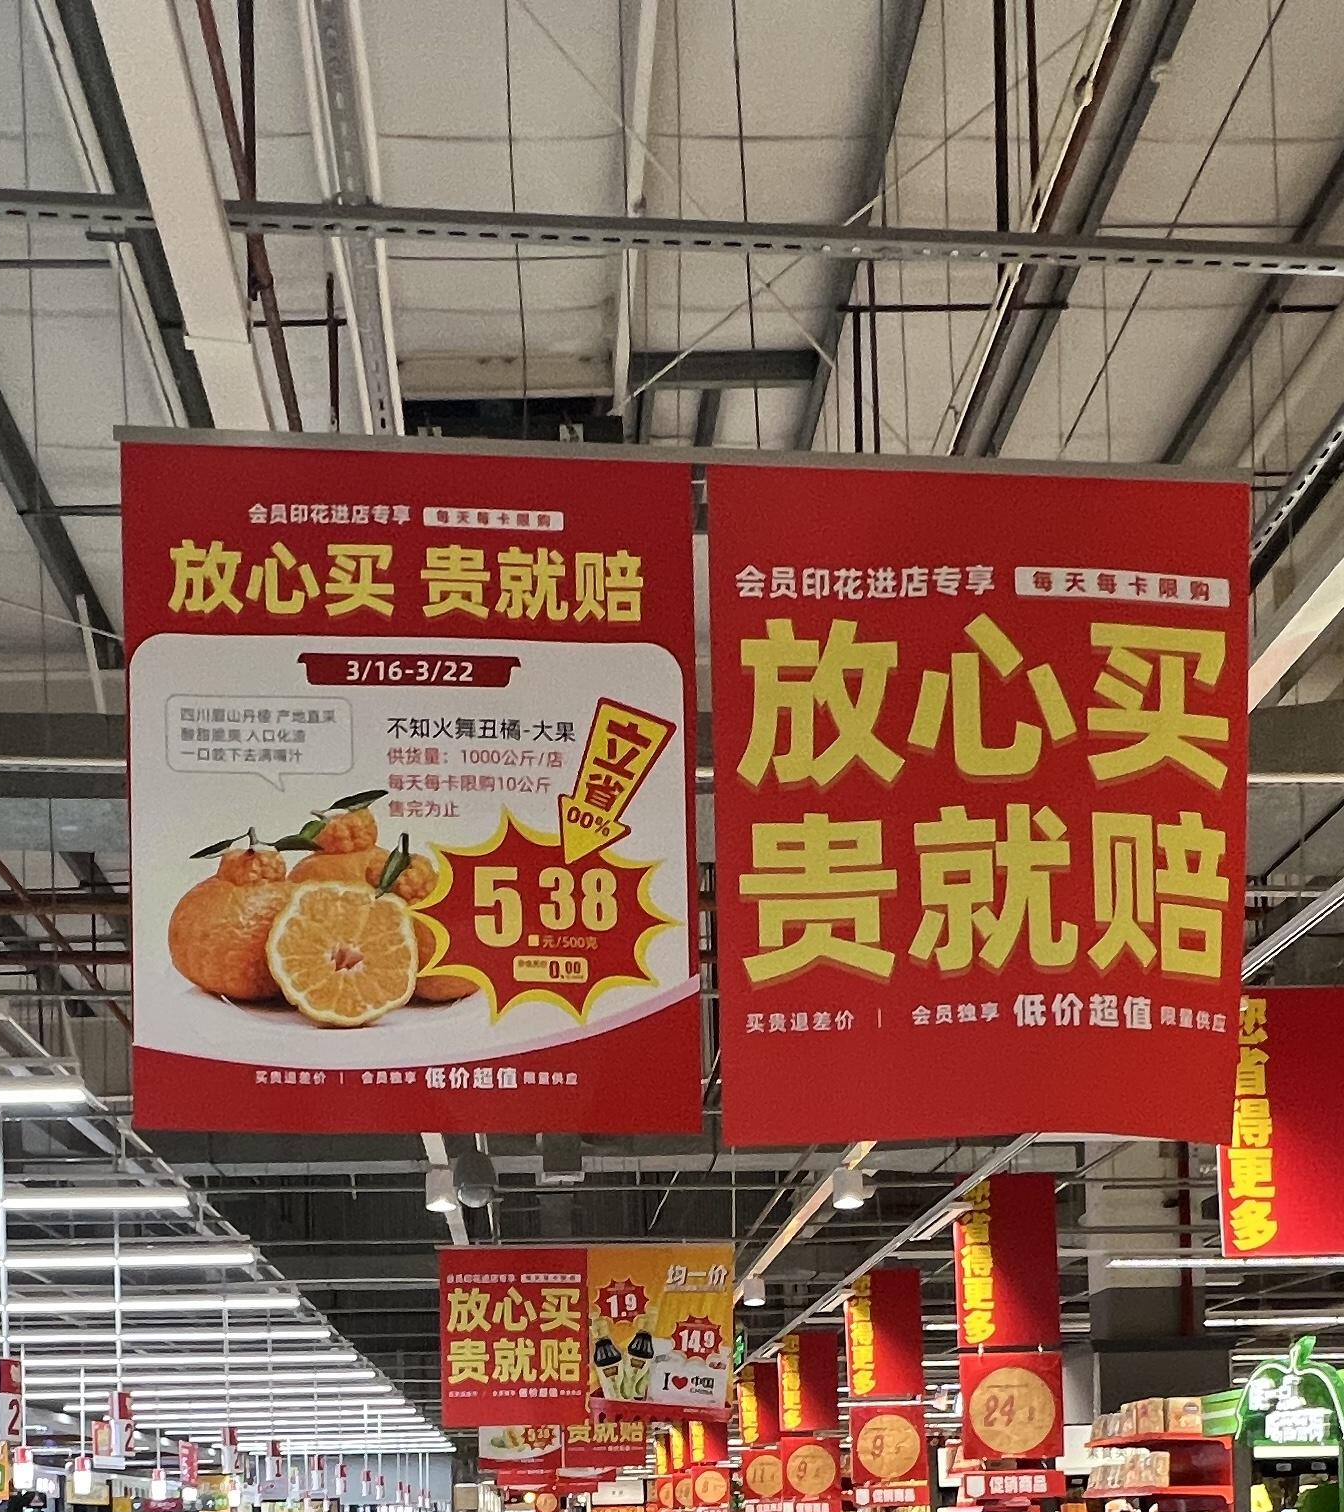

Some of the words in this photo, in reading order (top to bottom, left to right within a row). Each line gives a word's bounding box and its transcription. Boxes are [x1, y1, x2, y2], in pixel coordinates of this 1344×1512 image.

[248, 503, 411, 525] 会员印花进店专享
[436, 510, 551, 528] 每天每卡限购
[168, 539, 394, 617] 放心买
[421, 545, 644, 622] 贵就赔
[735, 564, 995, 599] 会员印花进店专享
[1032, 571, 1211, 602] 每天每卡限购
[346, 660, 473, 683] 3/16-3/22
[736, 613, 1231, 791] 放心买
[386, 717, 575, 742] 不知火舞丑橘-大果
[585, 719, 652, 812] 立省
[387, 774, 552, 794] 每天每卡限购10公斤
[387, 800, 459, 819] 售完为止
[738, 803, 1231, 984] 贵就赔
[746, 1011, 855, 1033] 买贵退差价
[911, 1004, 998, 1026] 会员独享
[1013, 993, 1153, 1030] 低价超值
[1160, 1006, 1228, 1033] 限量供应
[425, 1066, 518, 1089] 低价超值
[666, 1265, 728, 1286] 均一价
[447, 1287, 581, 1333] 放心买
[606, 1293, 638, 1317] 1.9
[679, 1330, 714, 1352] 14.9
[447, 1338, 581, 1384] 贵就赔
